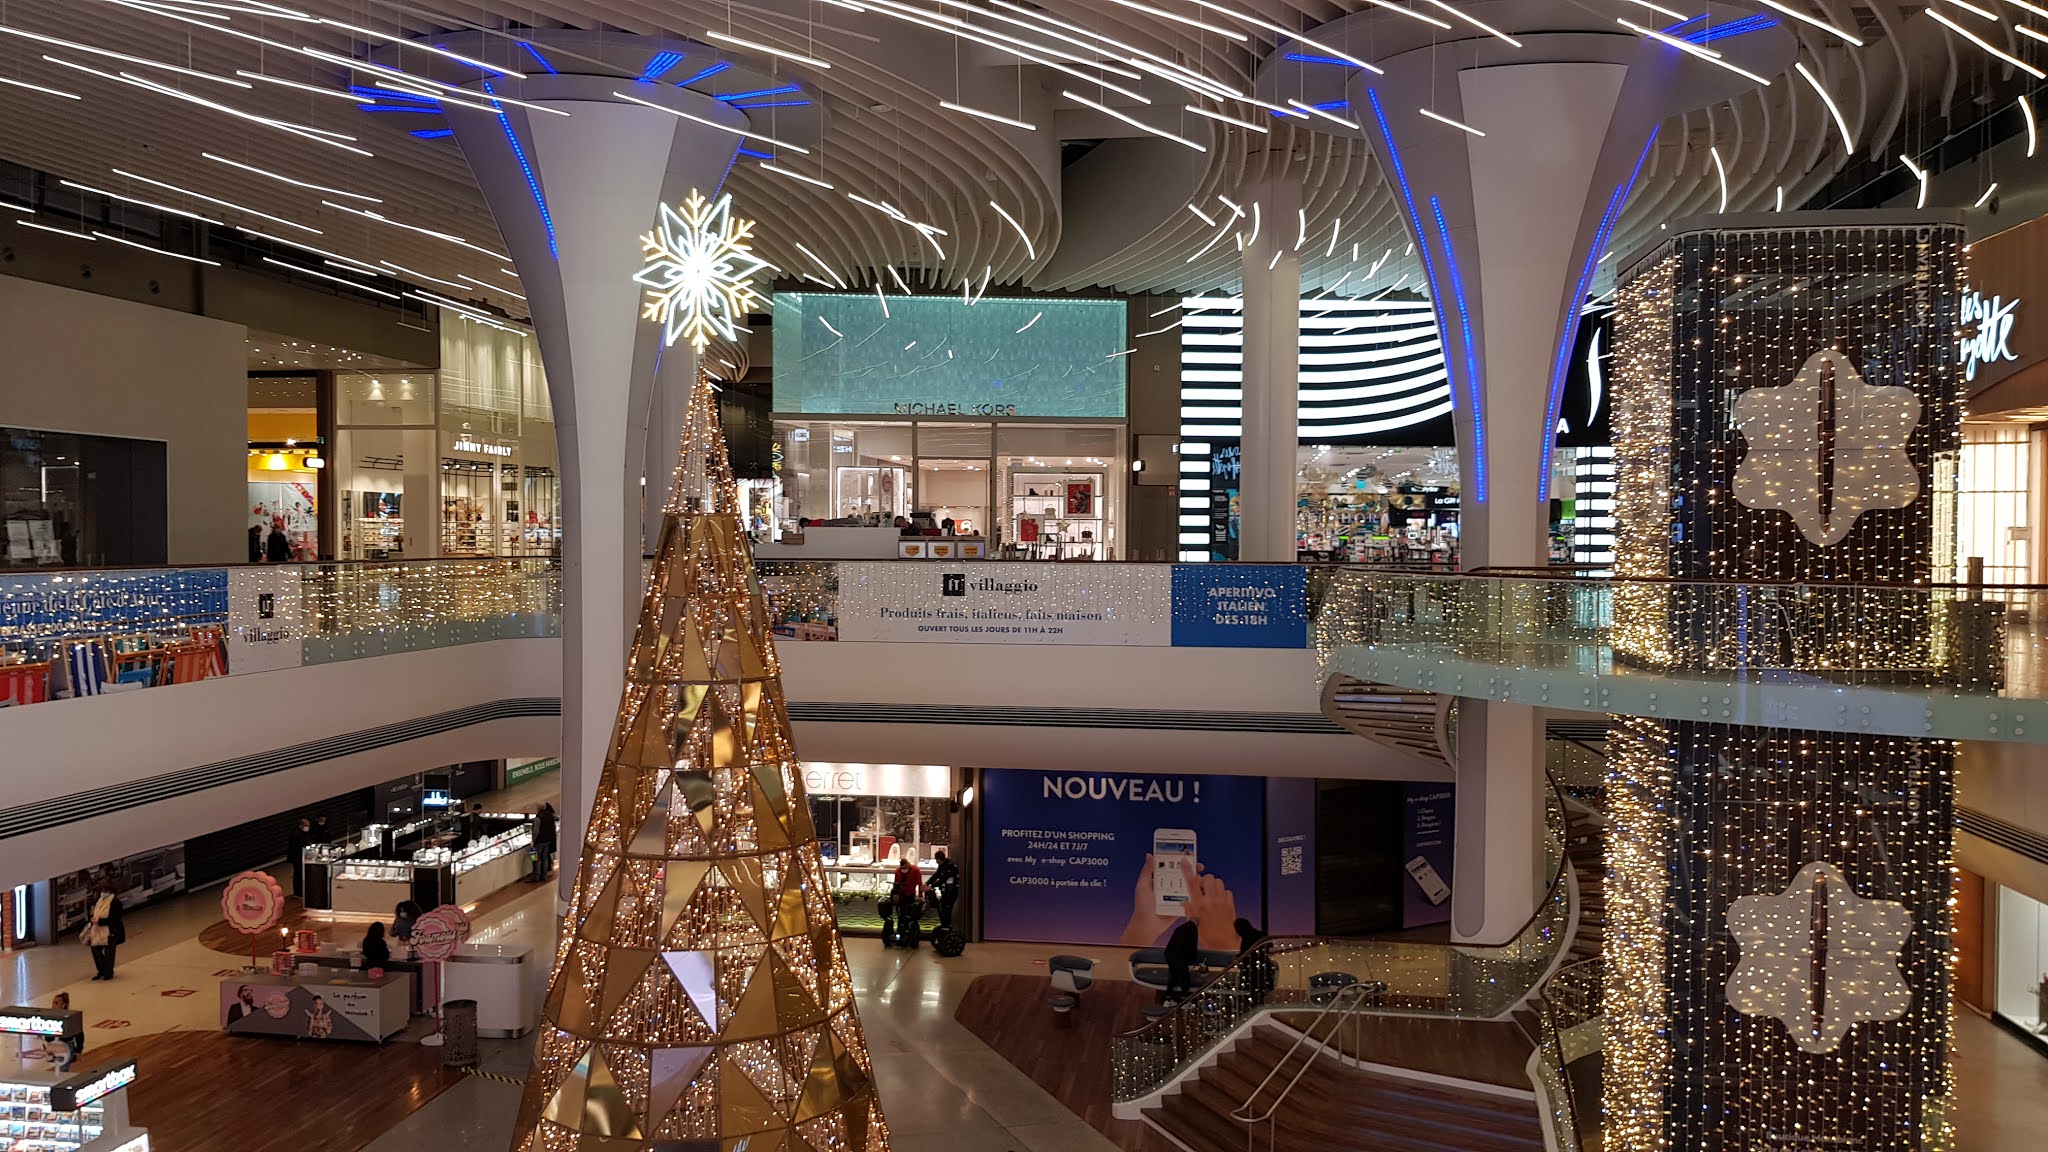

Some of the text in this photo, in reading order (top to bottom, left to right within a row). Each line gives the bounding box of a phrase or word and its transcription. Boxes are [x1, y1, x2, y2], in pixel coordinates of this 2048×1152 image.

[893, 402, 1016, 417] MICHAEL KORS
[483, 444, 512, 456] FAIRLY
[969, 578, 1038, 595] villaggio
[1208, 587, 1276, 598] APERITIVO
[1217, 601, 1265, 611] ITALIEN
[879, 607, 933, 619] Produits
[1024, 609, 1053, 621] faits
[1056, 610, 1103, 621] maison
[1244, 615, 1268, 625] 18H
[917, 625, 948, 633] OUVERT
[984, 626, 1011, 634] JOURS
[805, 770, 862, 790] erret
[1043, 776, 1200, 803] NOUVEAU !
[1001, 829, 1115, 841] PROFITEZ D'UN SHOPPING
[1027, 841, 1088, 851] 24H/24 ET 7J/7
[1024, 856, 1037, 866] My
[1041, 856, 1066, 867] e-shop
[1068, 857, 1109, 866] CAP3000
[1009, 876, 1049, 886] CAP3000
[1079, 879, 1089, 887] de
[1090, 879, 1102, 887] clic
[75, 1064, 135, 1104] smartbox
